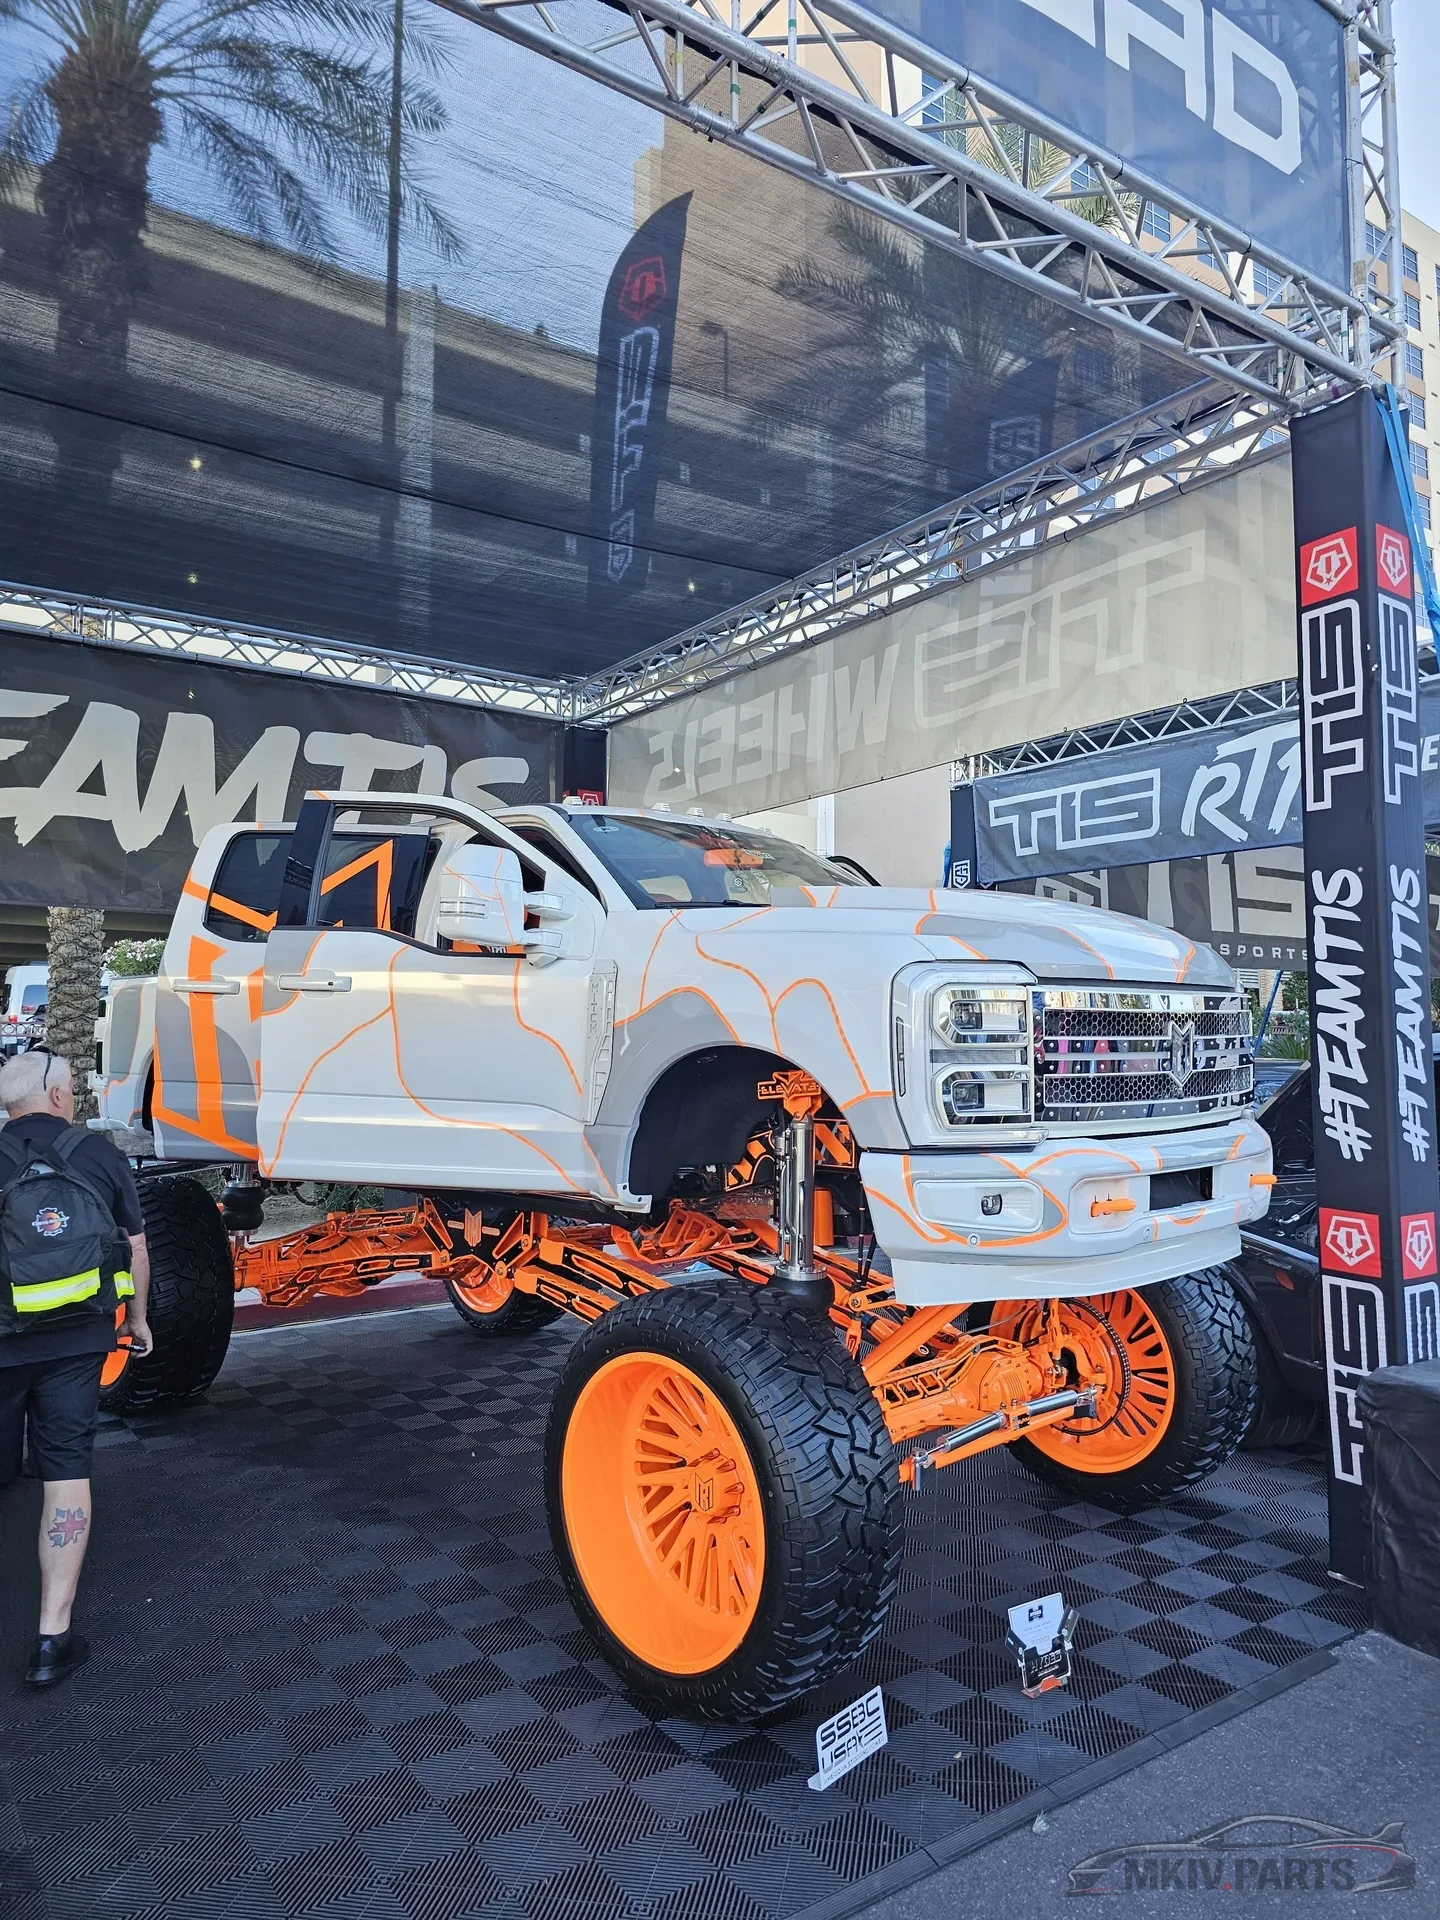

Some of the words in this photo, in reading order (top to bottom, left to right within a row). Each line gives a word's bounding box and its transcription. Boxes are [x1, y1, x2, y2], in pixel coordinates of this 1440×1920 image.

[1020, 0, 1302, 175] AD
[1302, 598, 1363, 812] TIS
[1378, 593, 1418, 805] TIS
[989, 768, 1161, 857] TIS
[1311, 868, 1372, 1162] #TEAMTIS
[1390, 864, 1430, 1162] #TEAMTIS
[820, 1692, 880, 1751] SSBC
[821, 1735, 858, 1775] USA
